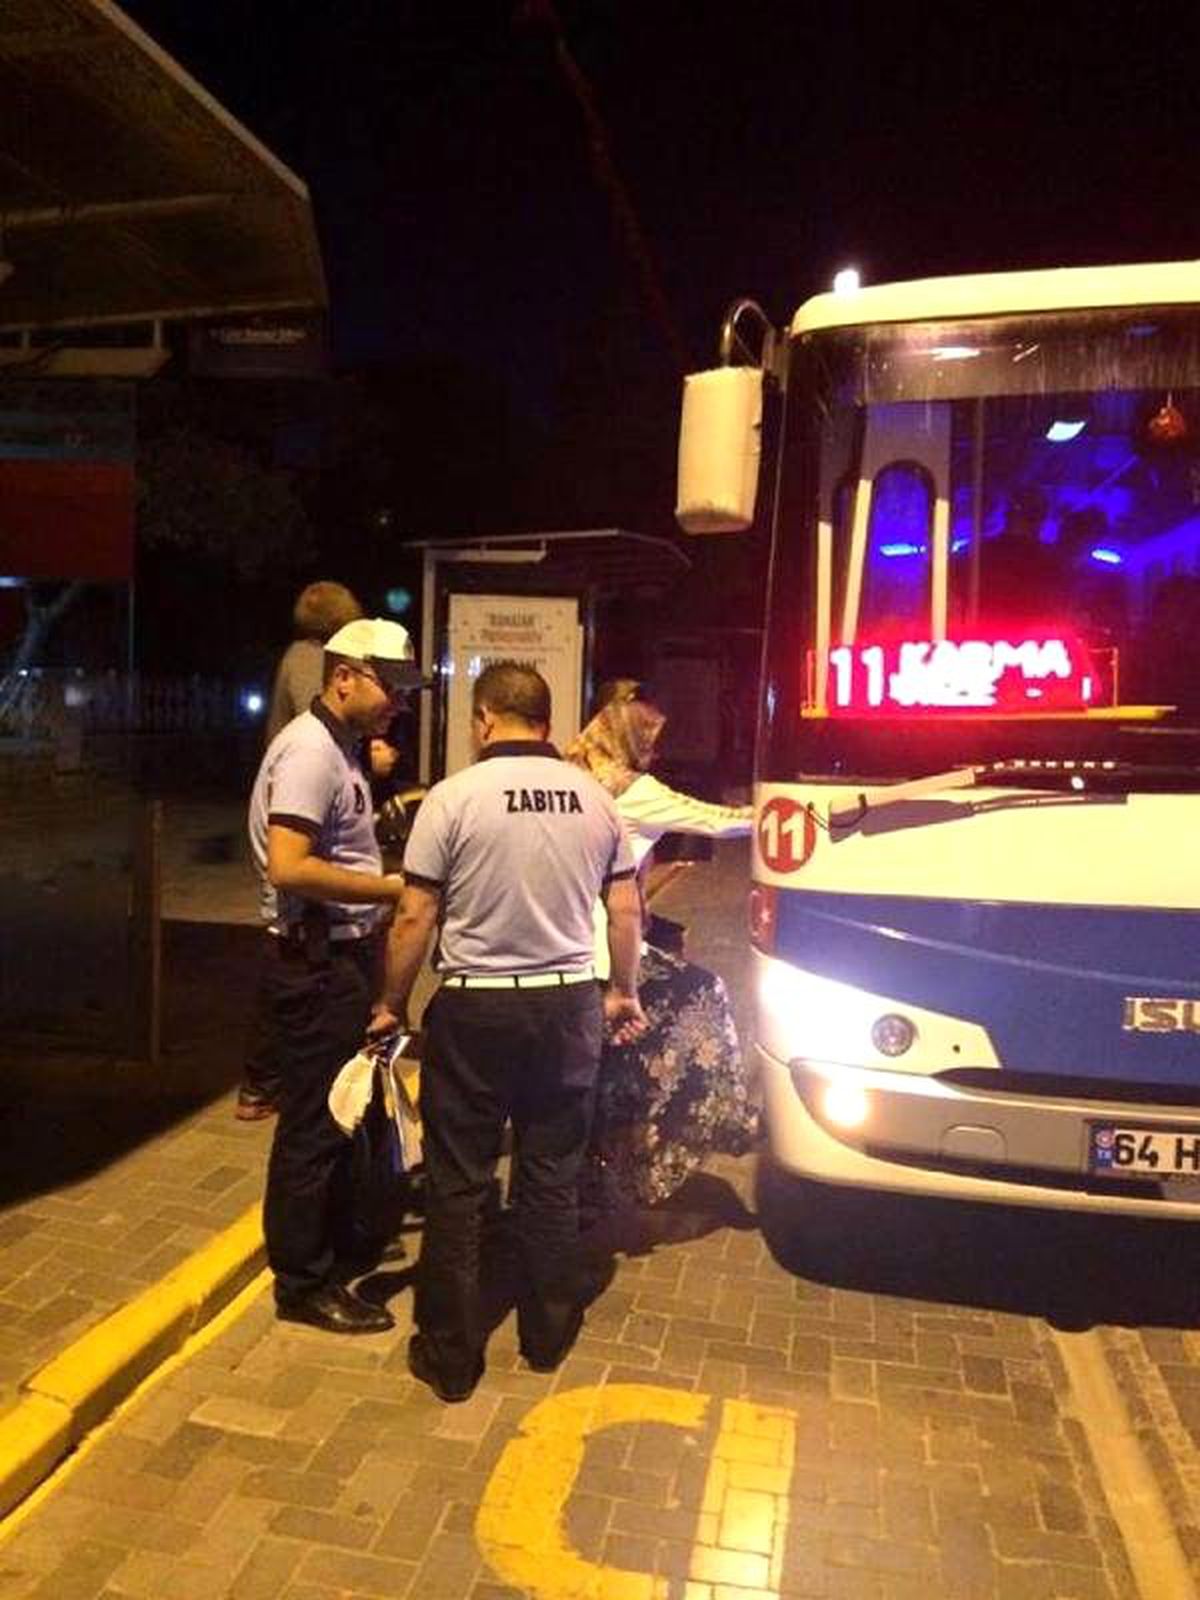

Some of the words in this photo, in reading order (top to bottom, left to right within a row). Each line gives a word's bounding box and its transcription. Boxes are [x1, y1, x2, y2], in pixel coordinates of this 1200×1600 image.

[829, 645, 883, 706] 11
[503, 788, 584, 813] ZABITA
[761, 810, 805, 860] 11
[1114, 1133, 1159, 1168] 64
[1175, 1137, 1200, 1171] H
